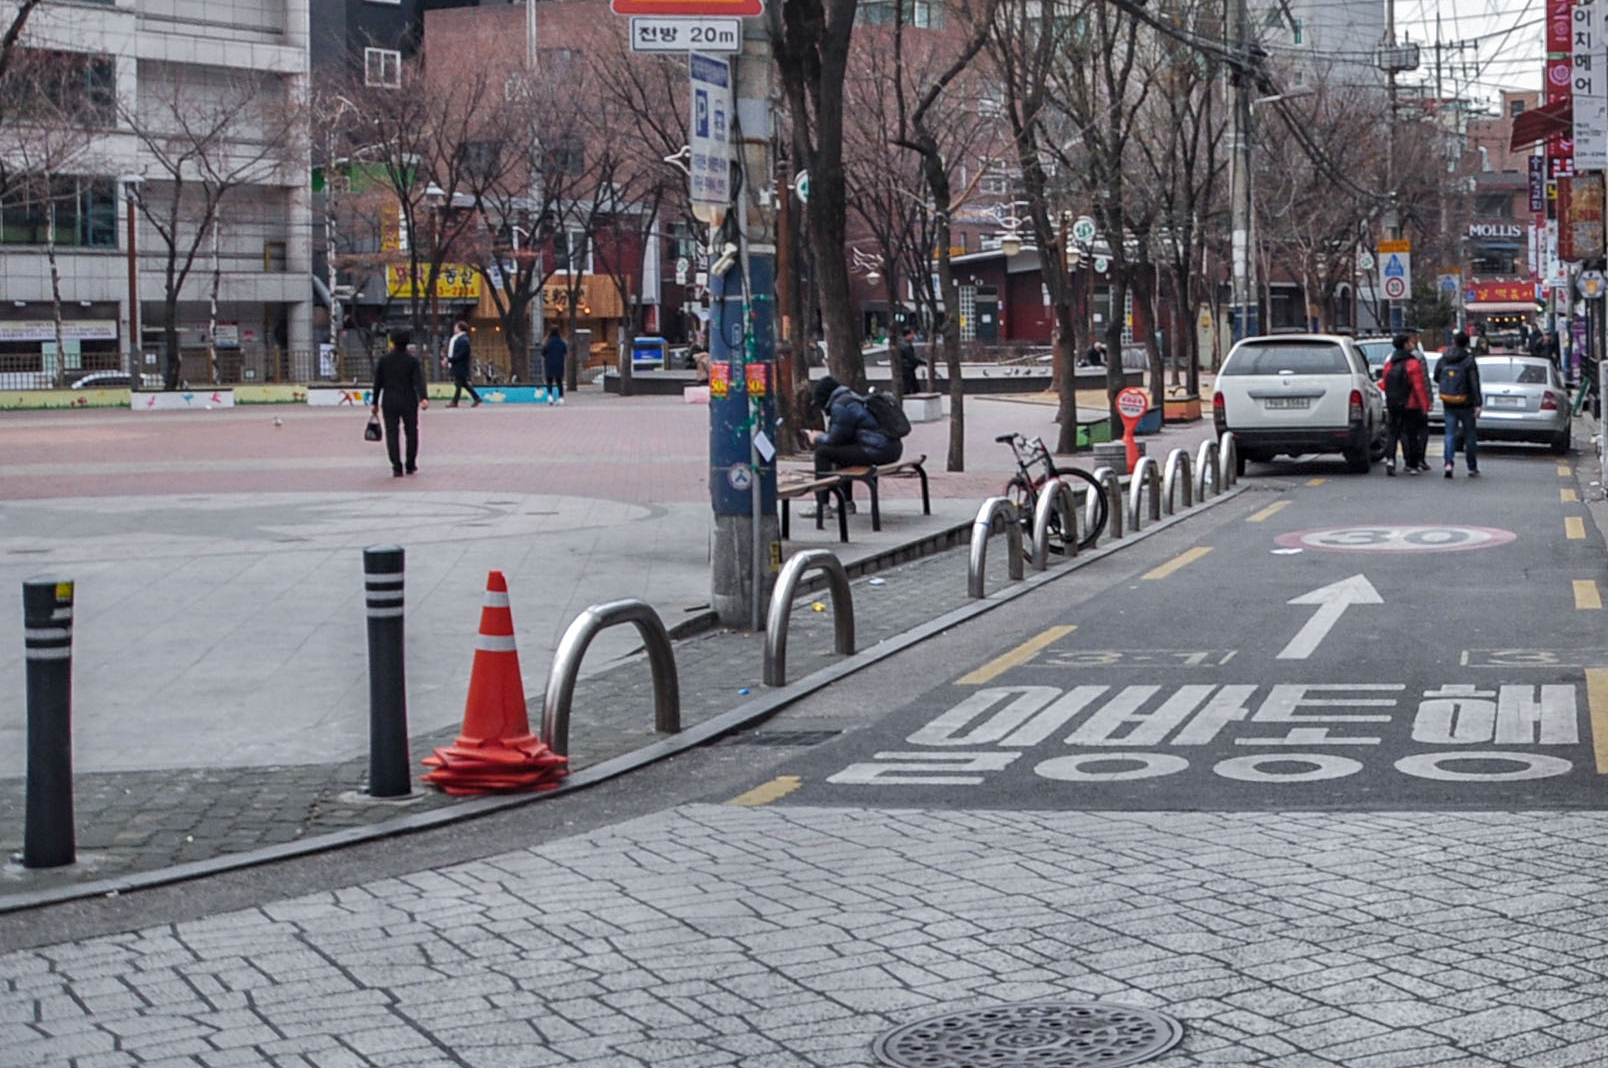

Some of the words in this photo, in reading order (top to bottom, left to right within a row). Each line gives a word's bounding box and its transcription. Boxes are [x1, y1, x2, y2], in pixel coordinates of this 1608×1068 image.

[638, 26, 679, 43] 전방
[689, 26, 735, 44] 20m
[1574, 9, 1592, 95] 이치헤어
[1469, 224, 1522, 238] MOLLIS
[826, 683, 1580, 785] 일방통행
